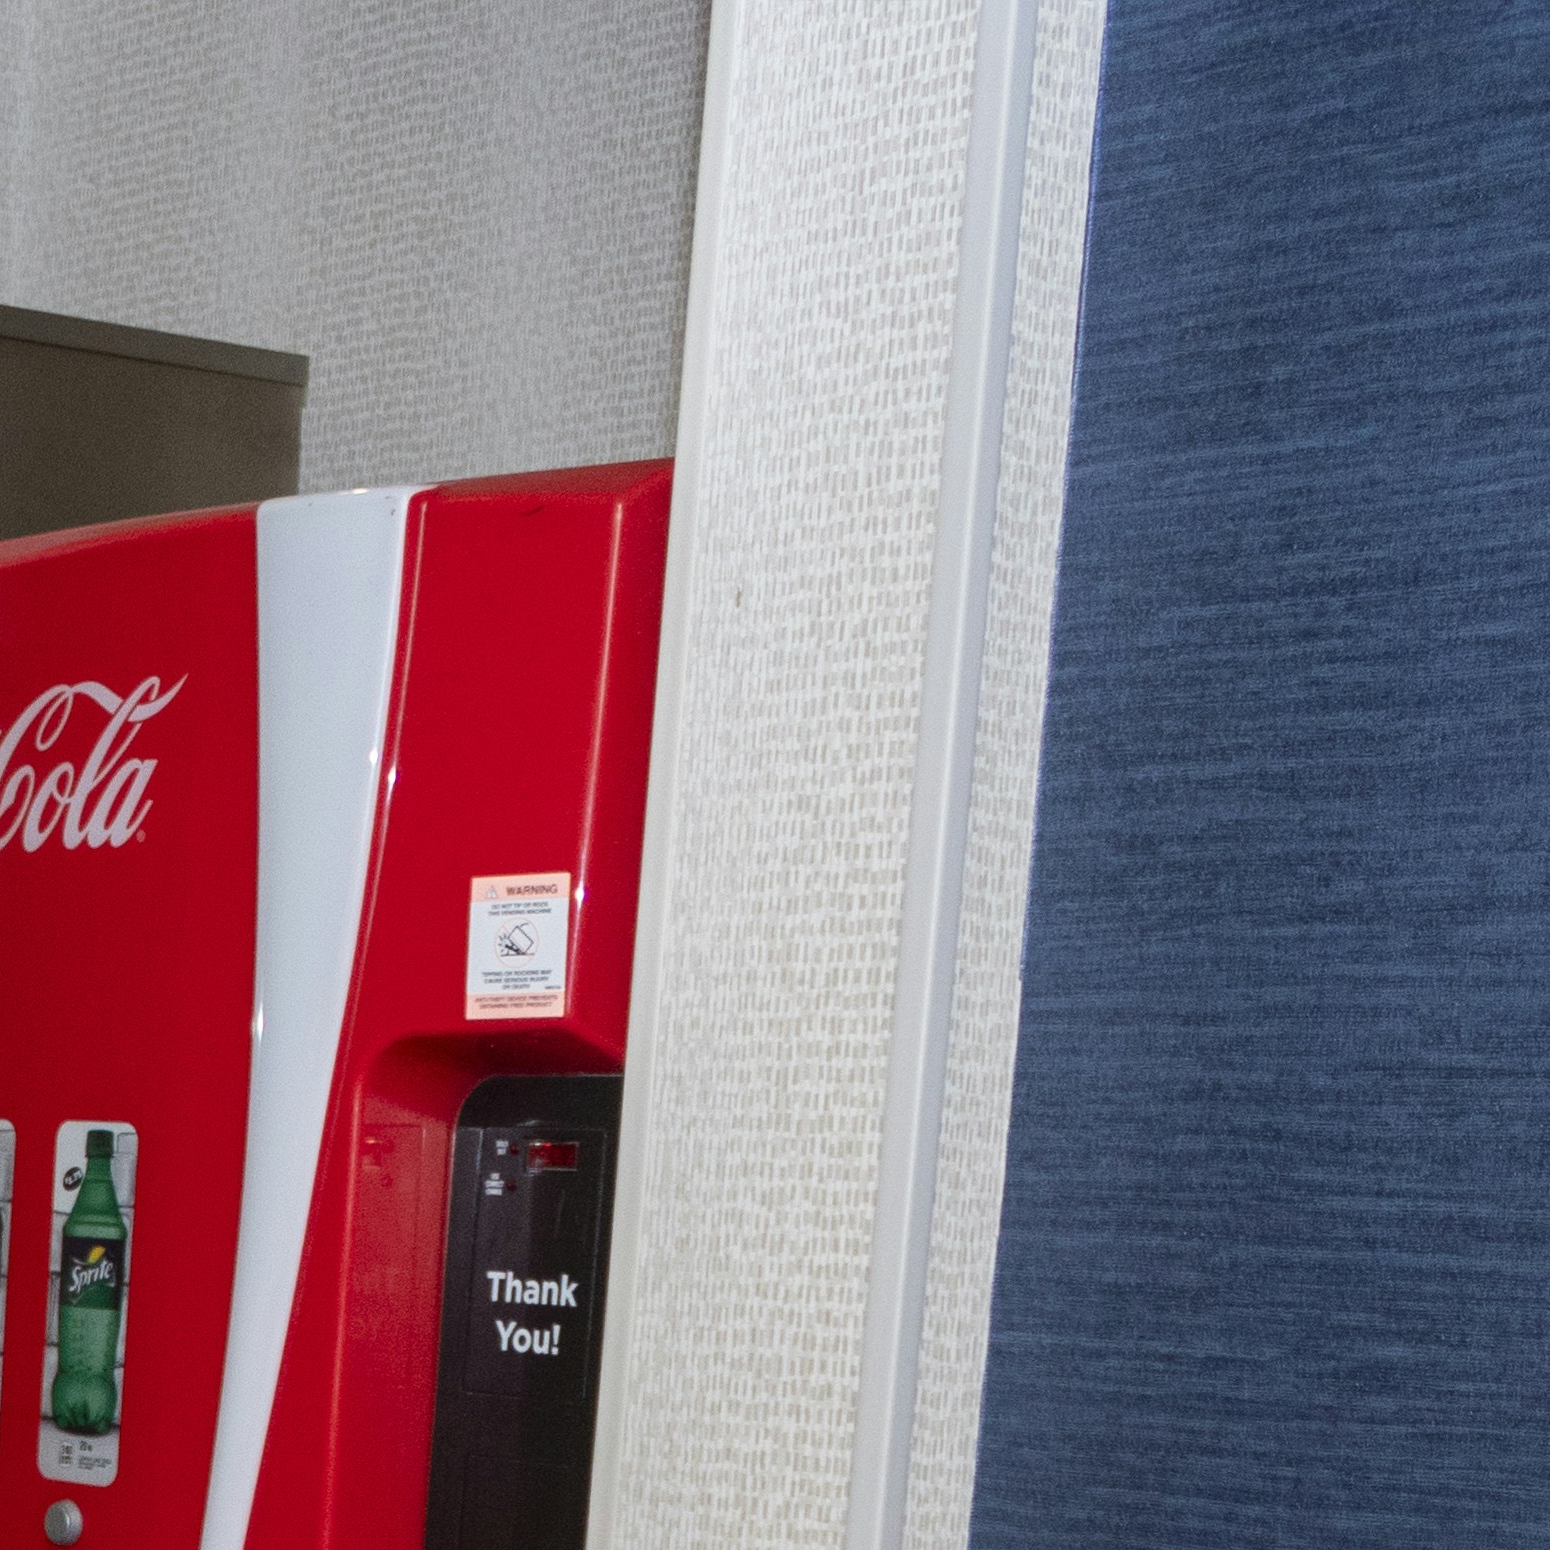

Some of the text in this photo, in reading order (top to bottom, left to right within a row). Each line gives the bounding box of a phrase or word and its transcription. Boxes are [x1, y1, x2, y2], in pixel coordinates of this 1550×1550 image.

[506, 883, 559, 896] WARNING
[68, 1259, 114, 1294] Sprite
[485, 1270, 579, 1308] Thank
[495, 1319, 561, 1356] You!
